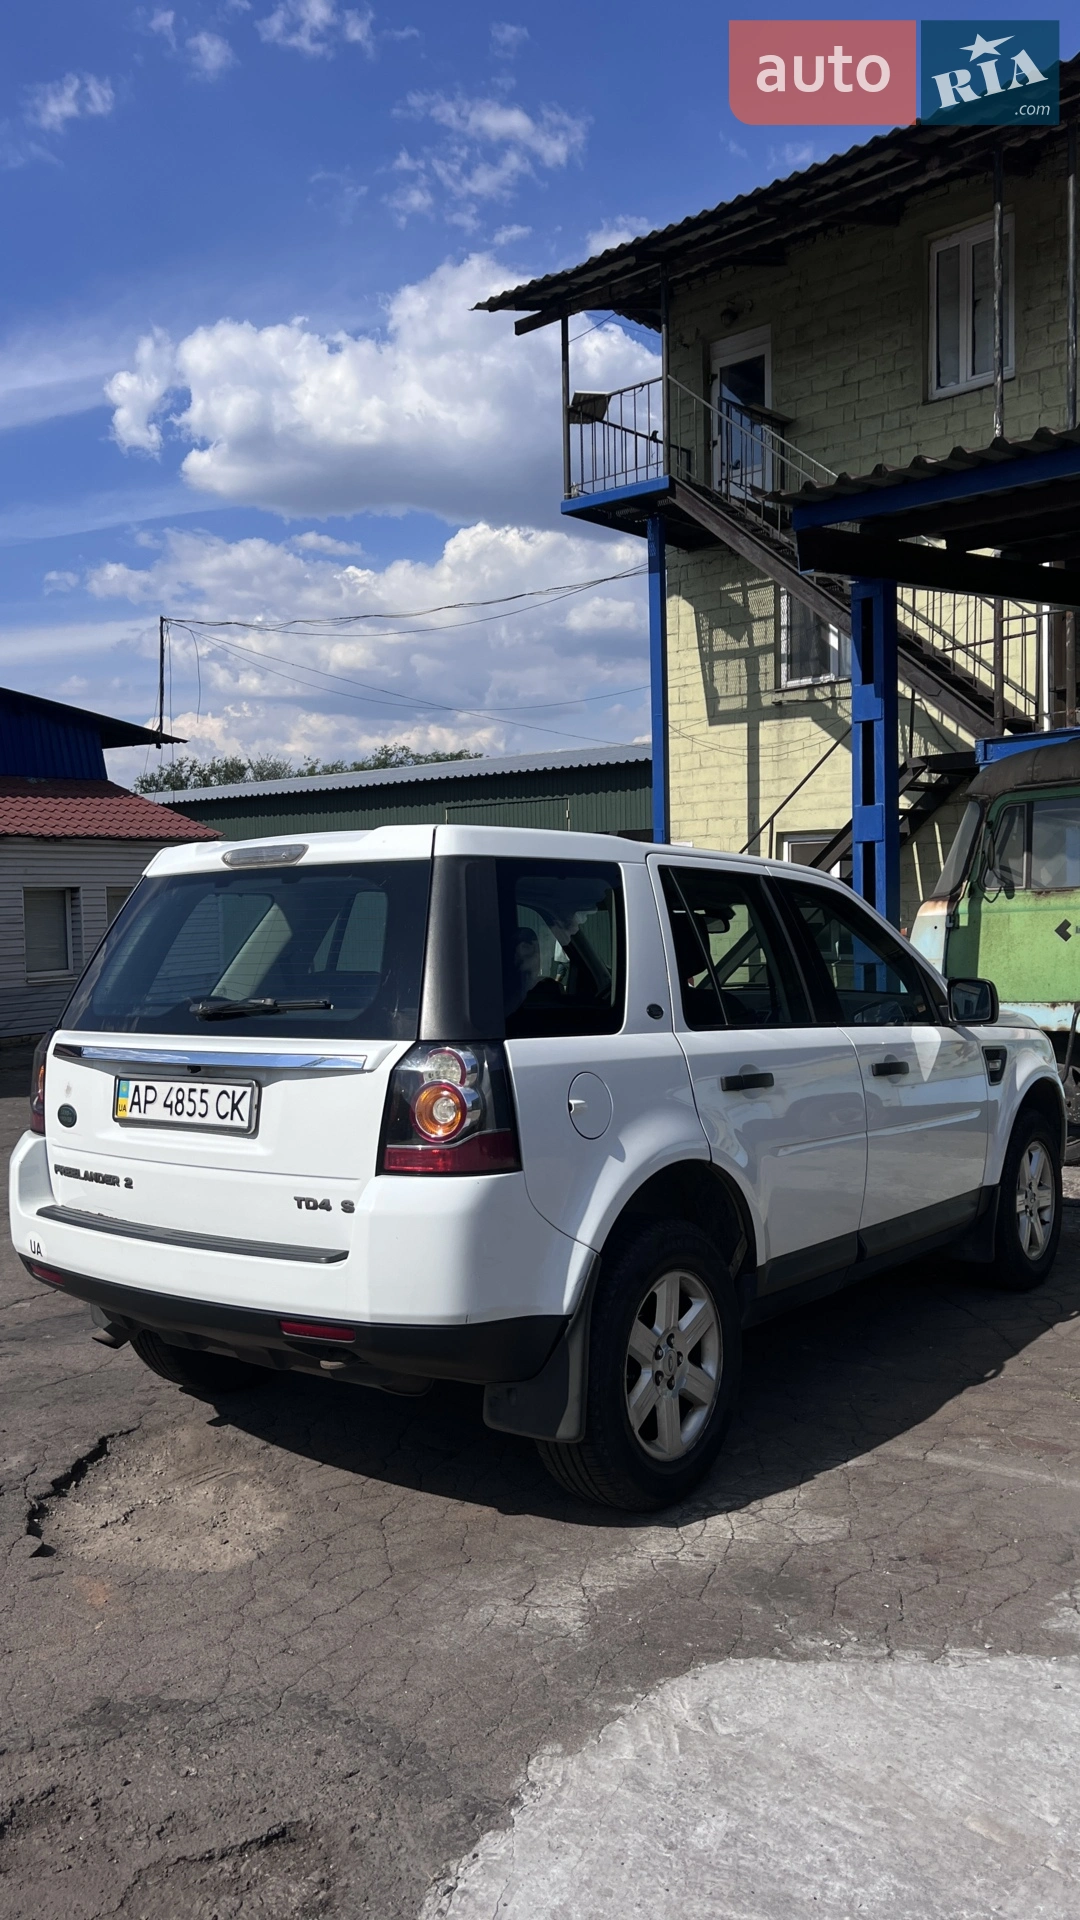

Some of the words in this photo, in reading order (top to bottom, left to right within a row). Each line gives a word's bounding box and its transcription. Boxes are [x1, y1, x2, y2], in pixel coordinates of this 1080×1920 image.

[118, 1103, 127, 1112] UA
[129, 1084, 158, 1114] AP
[163, 1086, 209, 1118] 4855
[216, 1090, 248, 1121] CK
[53, 1163, 121, 1187] FREELANDER
[123, 1176, 134, 1189] 2
[293, 1196, 333, 1212] TD4
[340, 1199, 356, 1214] S
[29, 1239, 44, 1258] UA
